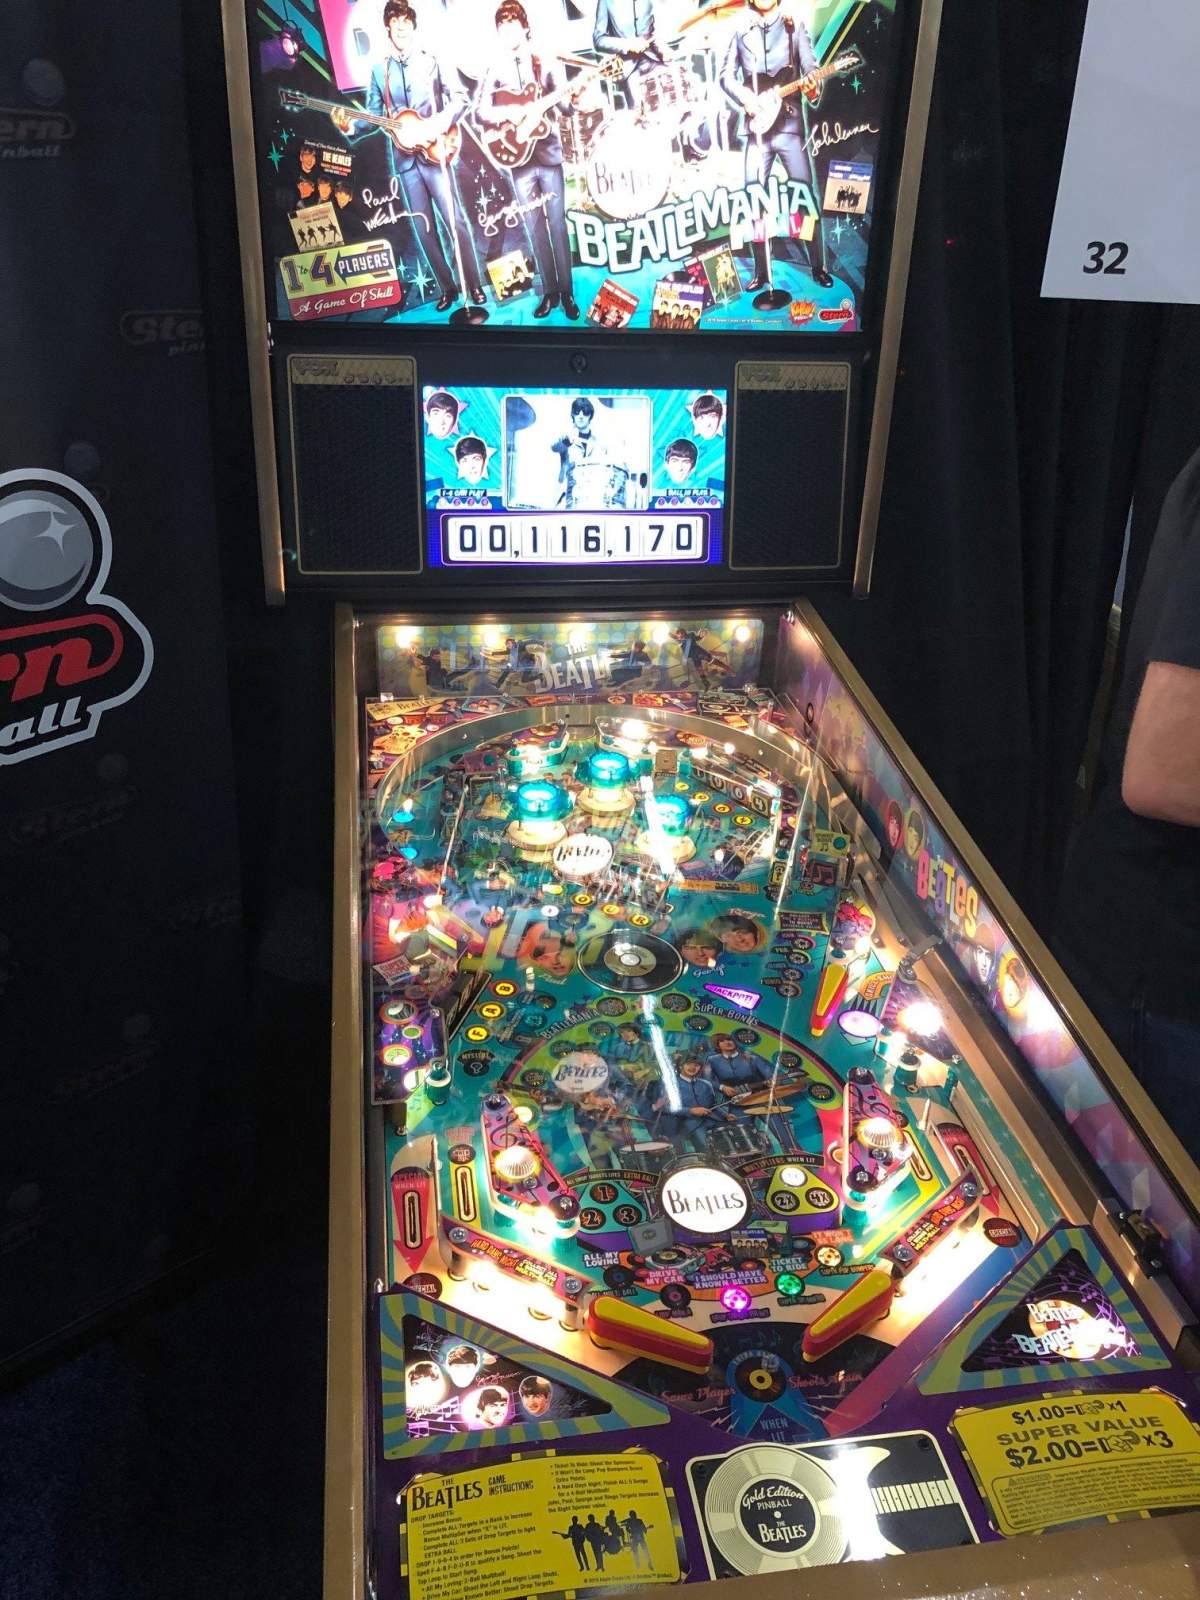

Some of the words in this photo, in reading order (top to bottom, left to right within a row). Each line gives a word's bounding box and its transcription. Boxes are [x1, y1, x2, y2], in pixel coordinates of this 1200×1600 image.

[1083, 241, 1129, 275] 32
[282, 258, 304, 293] 1
[310, 252, 336, 287] 4
[338, 251, 390, 275] PLAYERS
[293, 300, 311, 317] A
[314, 299, 346, 314] Game
[349, 290, 368, 309] Of
[369, 285, 394, 301] Skill
[469, 489, 486, 497] PLAY
[459, 523, 693, 558] 00,116,170
[667, 1188, 745, 1216] BEATLES
[619, 1205, 637, 1224] 3
[584, 1252, 602, 1261] ALL
[605, 1251, 619, 1261] MY
[585, 1257, 620, 1267] LOVING
[772, 1257, 802, 1266] TICKET
[648, 1269, 679, 1279] DRIVE
[772, 1264, 784, 1272] TO
[786, 1263, 808, 1272] RIDE
[645, 1277, 662, 1286] MY
[663, 1275, 685, 1285] CAR
[694, 1278, 729, 1289] KNOWN
[733, 1276, 769, 1286] BETTER
[700, 1271, 737, 1282] SHOULD
[737, 1269, 763, 1278] HAVE
[696, 1385, 736, 1406] Player
[760, 1418, 789, 1431] WHEN
[996, 1423, 1080, 1446] SUPER
[1085, 1415, 1164, 1434] VALUE
[441, 1478, 454, 1487] THE
[488, 1479, 534, 1497] INSTRUCTIONS
[411, 1481, 483, 1511] BEATLES
[742, 1488, 765, 1509] Gold
[766, 1485, 805, 1500] Edition
[756, 1500, 792, 1510] PINBALL
[757, 1522, 807, 1544] BEATLES
